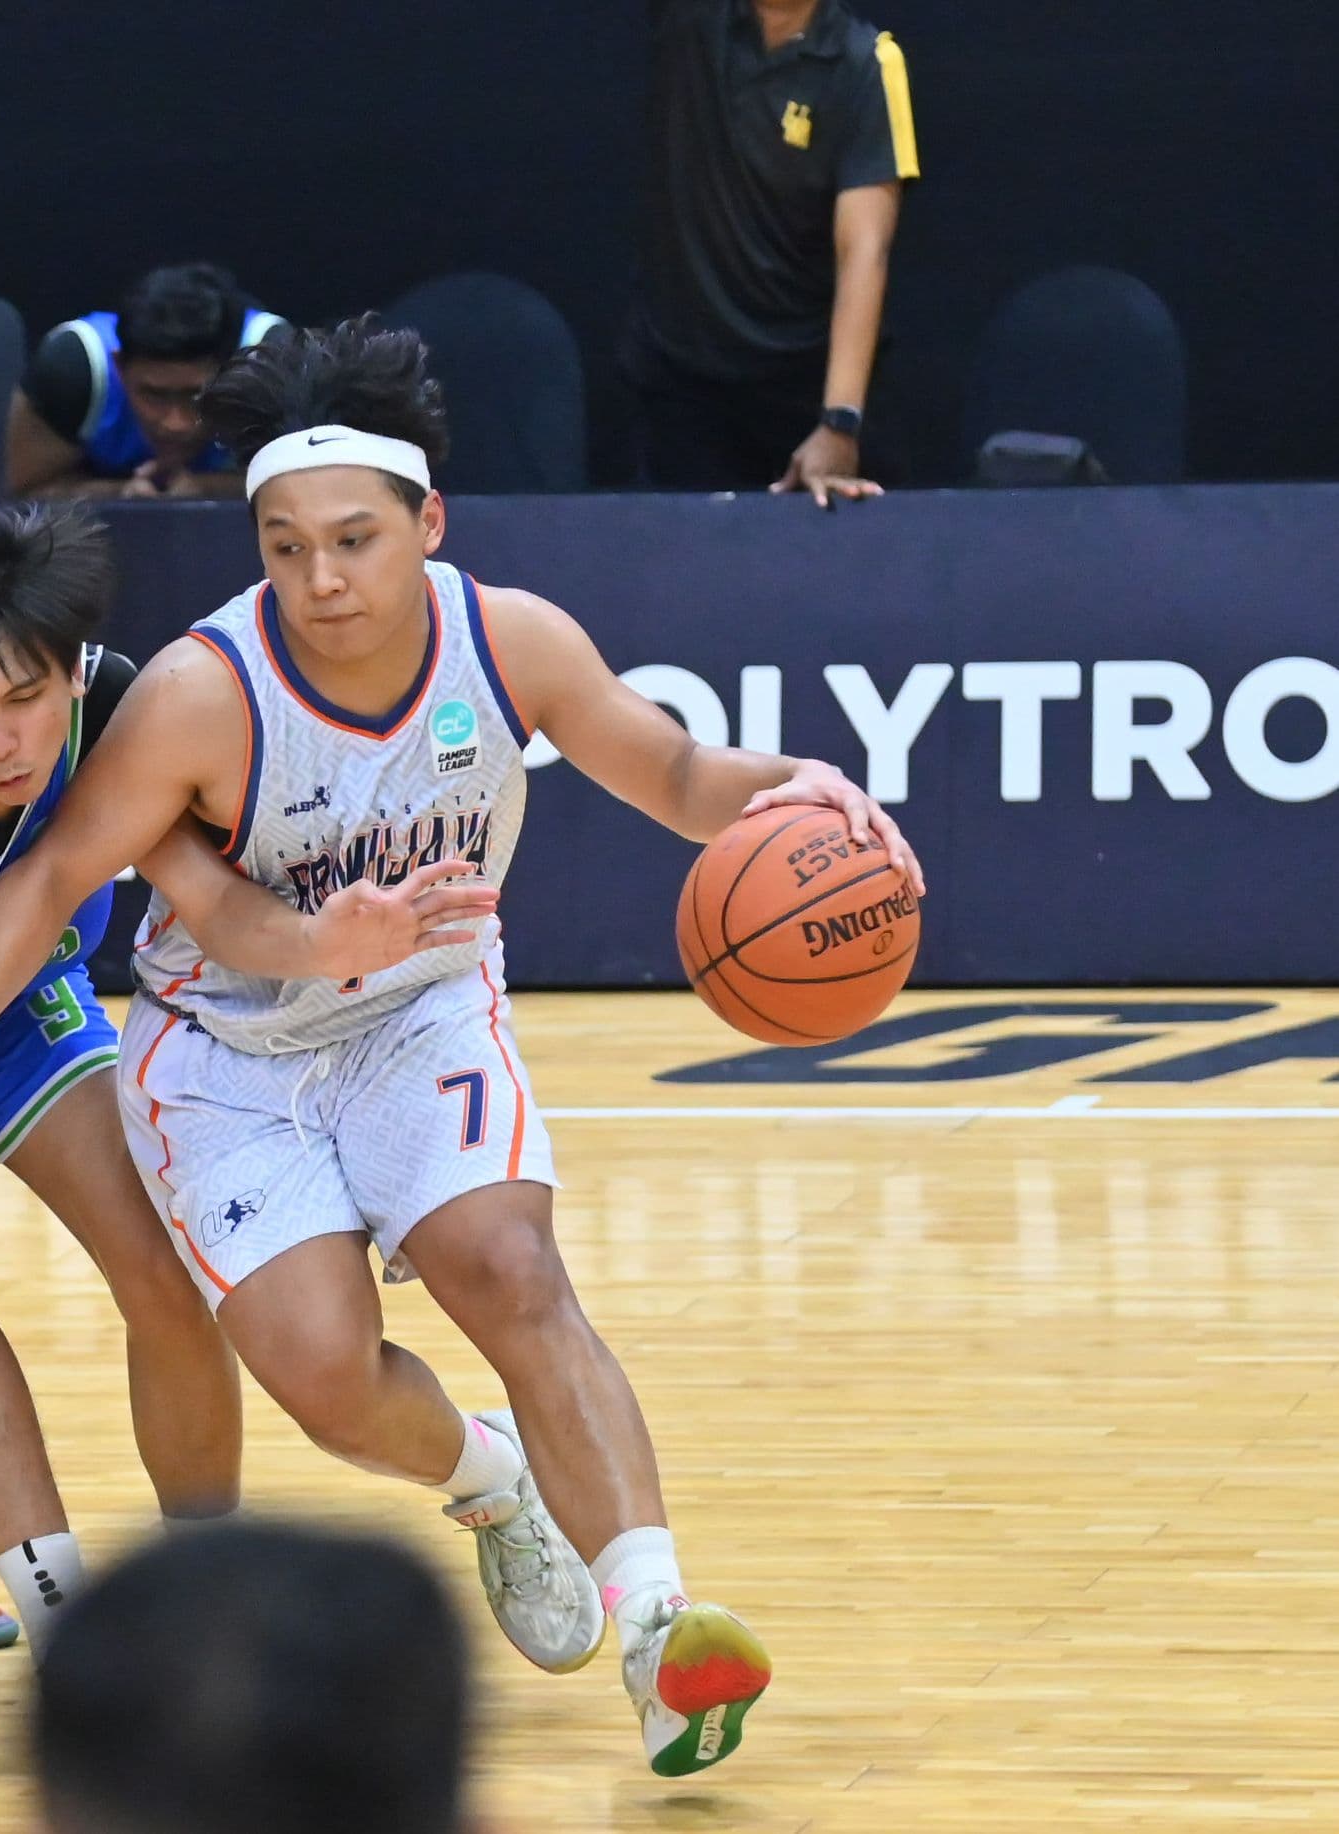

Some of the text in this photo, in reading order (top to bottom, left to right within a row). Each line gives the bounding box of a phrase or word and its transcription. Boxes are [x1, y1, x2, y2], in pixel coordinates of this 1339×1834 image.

[437, 746, 478, 763] CAMPUS
[439, 756, 476, 773] LEAGUE
[802, 877, 918, 958] PALDING
[435, 1067, 490, 1153] 7
